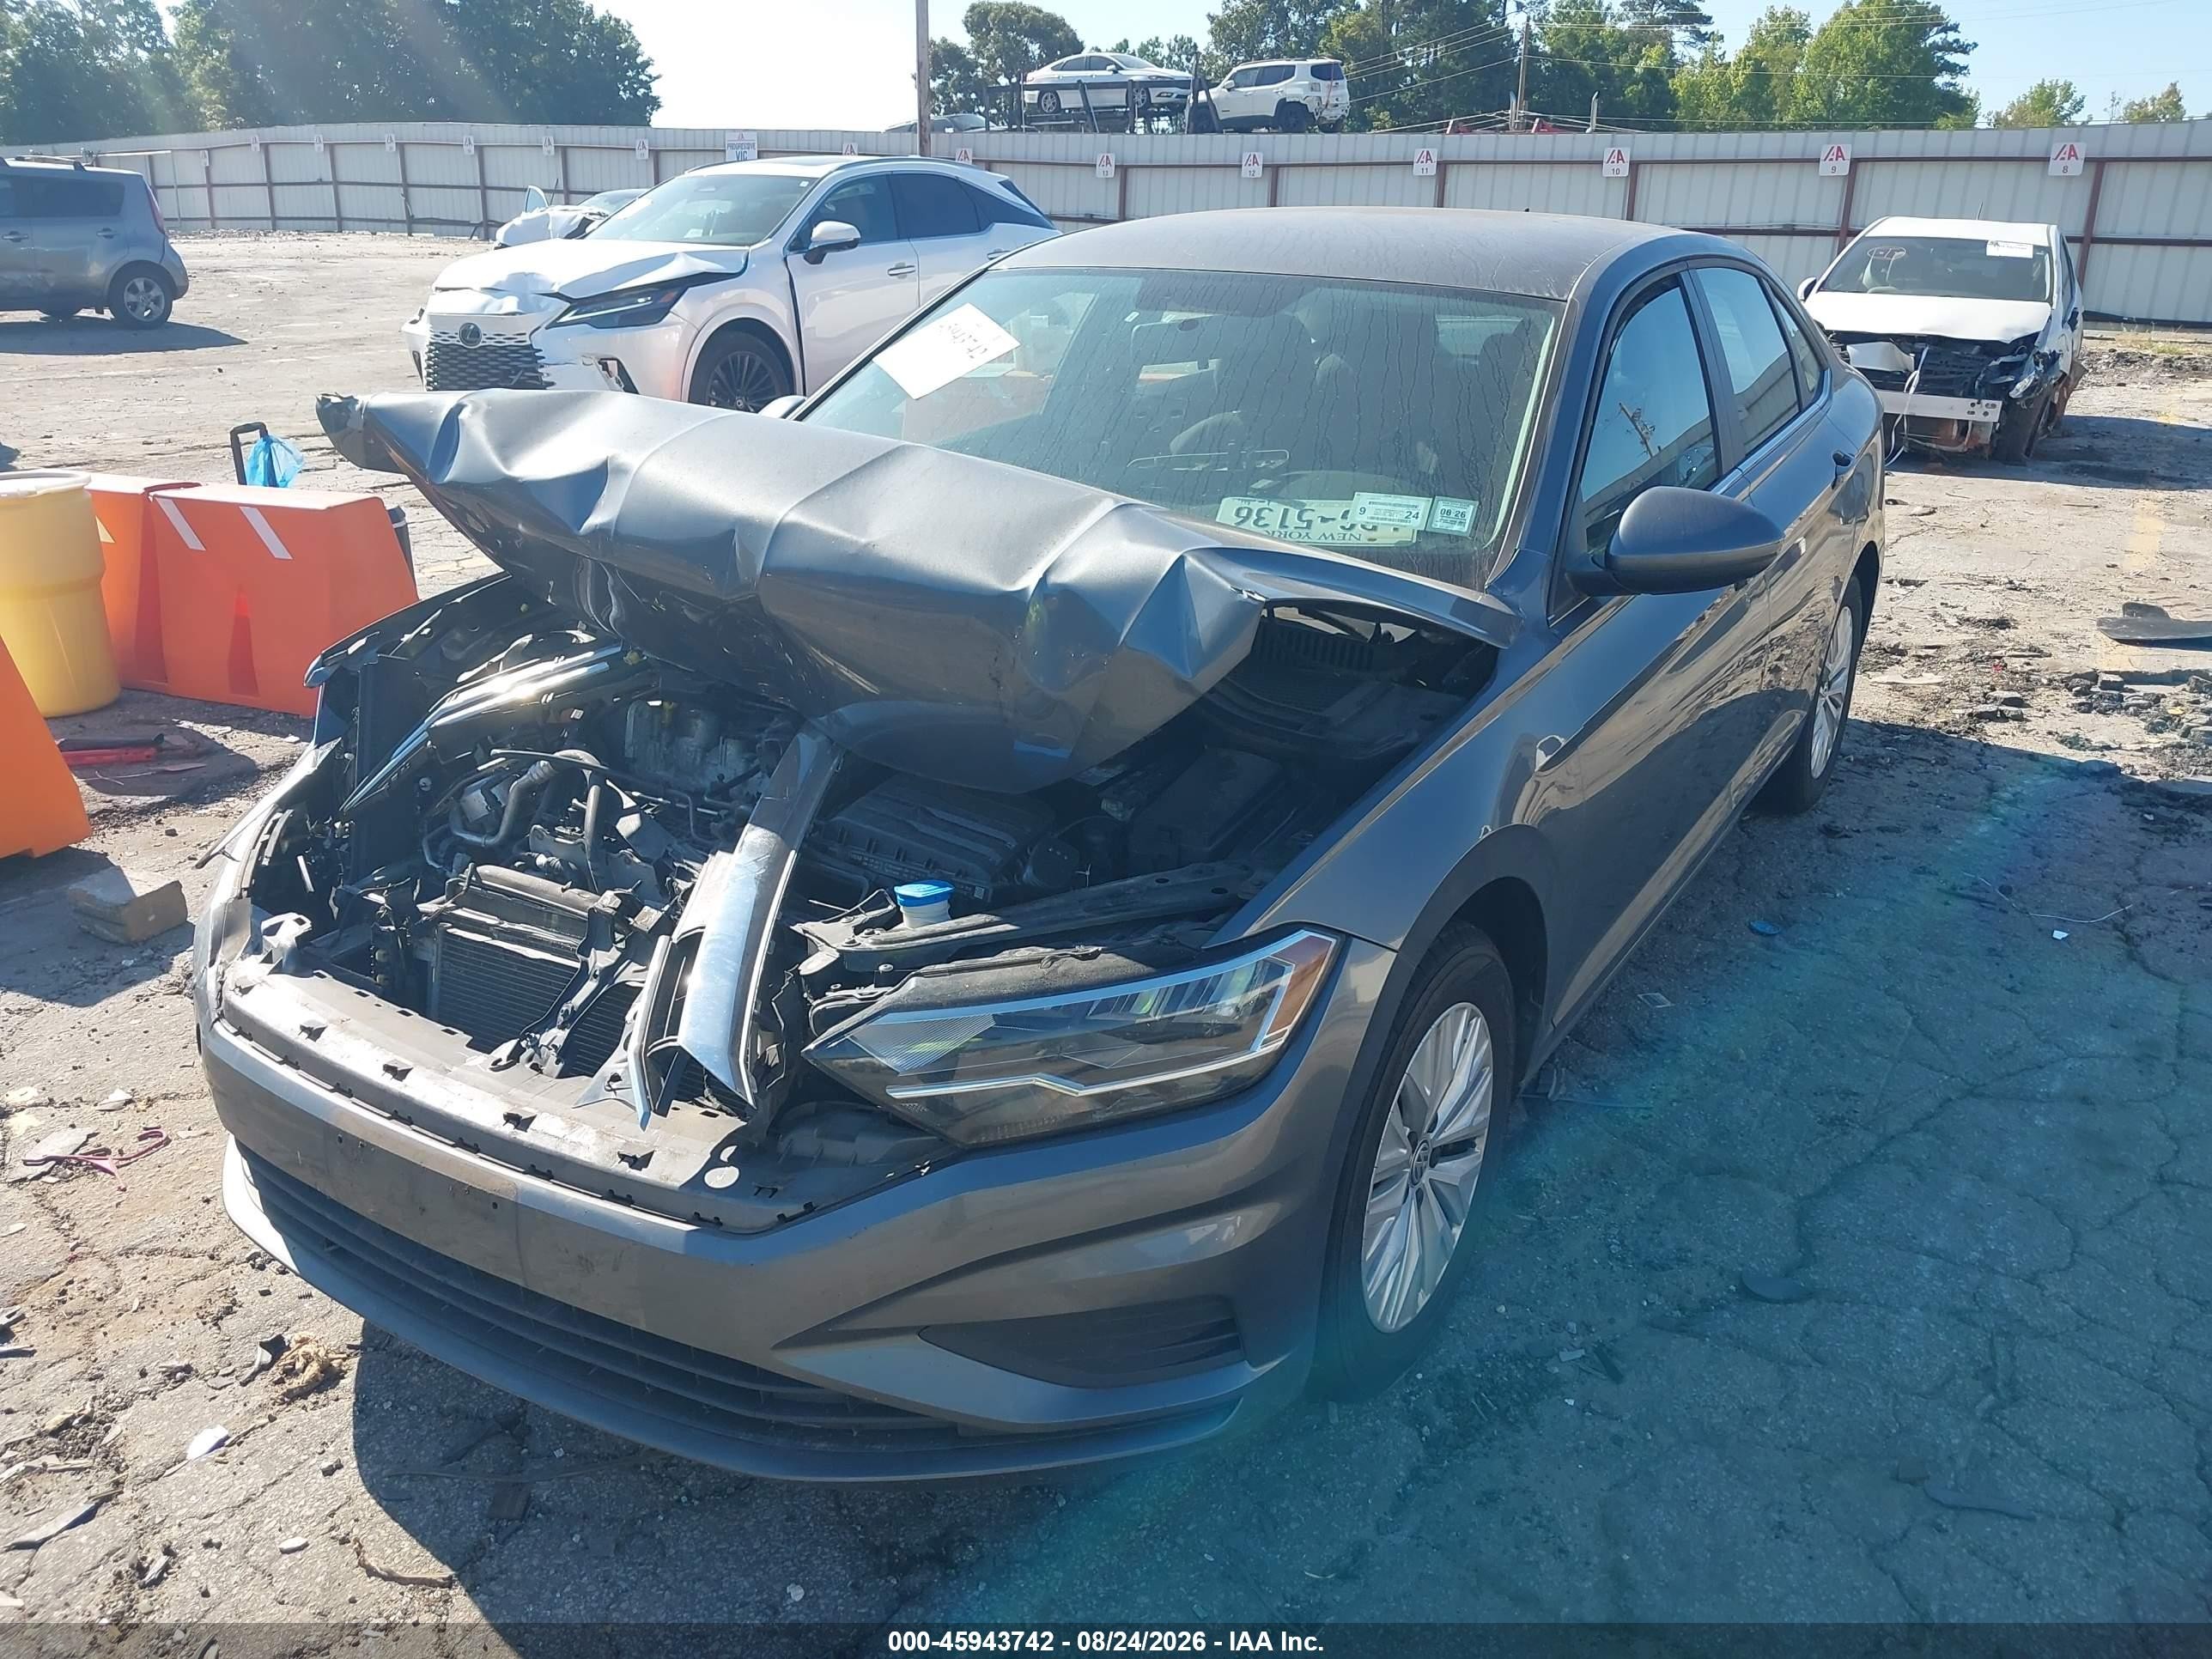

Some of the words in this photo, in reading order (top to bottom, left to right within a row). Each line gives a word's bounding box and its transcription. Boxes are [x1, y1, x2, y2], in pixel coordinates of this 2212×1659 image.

[735, 150, 748, 161] VIC
[1358, 507, 1366, 515] 9
[1404, 510, 1419, 520] 24
[1454, 509, 1466, 519] 26
[1318, 532, 1362, 542] NEW
